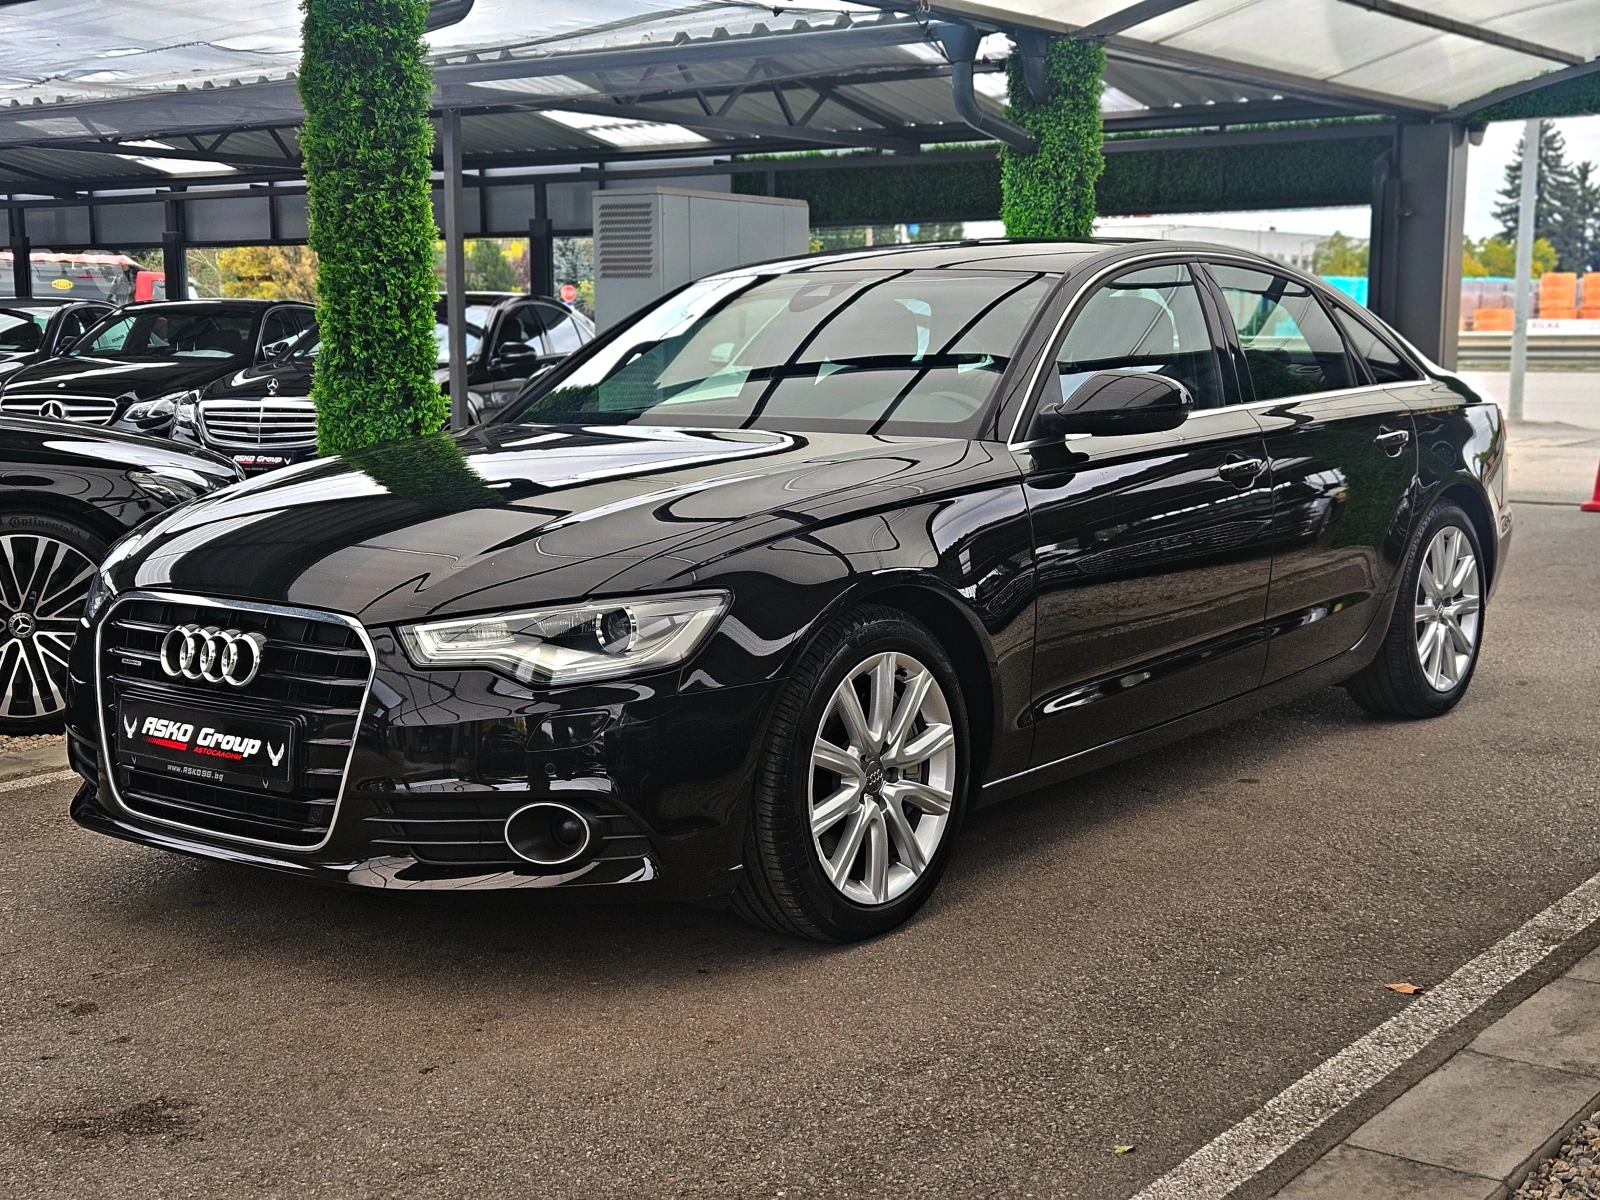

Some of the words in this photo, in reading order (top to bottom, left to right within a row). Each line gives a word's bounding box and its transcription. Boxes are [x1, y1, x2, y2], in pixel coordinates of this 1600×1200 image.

[256, 455, 283, 463] Group
[8, 516, 75, 536] Continental
[141, 716, 194, 742] ASKO
[196, 727, 262, 757] Group
[193, 746, 242, 760] АВТОСАЛОНИ
